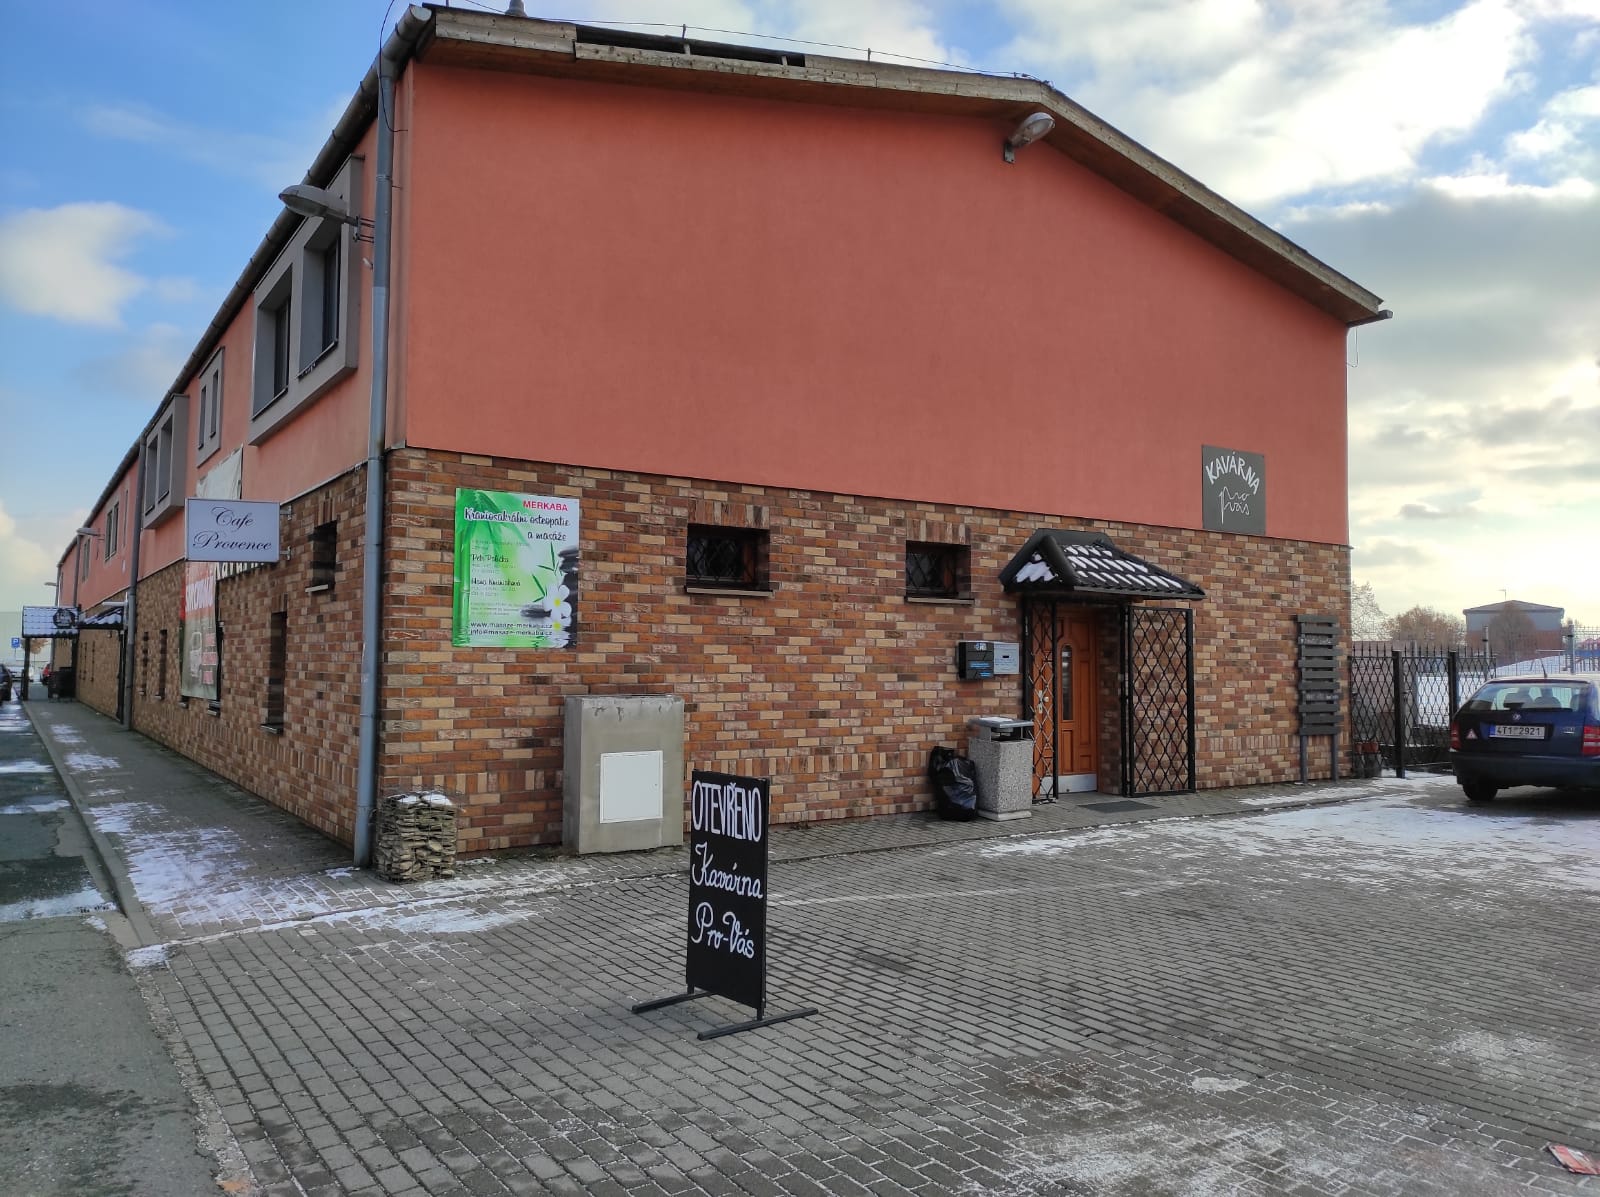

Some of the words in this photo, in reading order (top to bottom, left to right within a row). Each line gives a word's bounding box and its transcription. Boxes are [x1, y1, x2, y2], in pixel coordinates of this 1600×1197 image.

[1205, 451, 1260, 495] KAVÁRNA
[523, 500, 568, 511] MERKABA
[211, 506, 254, 533] Cafe
[530, 514, 570, 528] osteopatie
[192, 530, 272, 551] Provence
[536, 530, 567, 541] masáže
[1497, 726, 1512, 735] 4T1
[1519, 727, 1540, 736] 2921
[692, 780, 762, 842] OTEVŘENO
[692, 842, 763, 899] Kavárna
[691, 902, 755, 959] Pro-Vás
